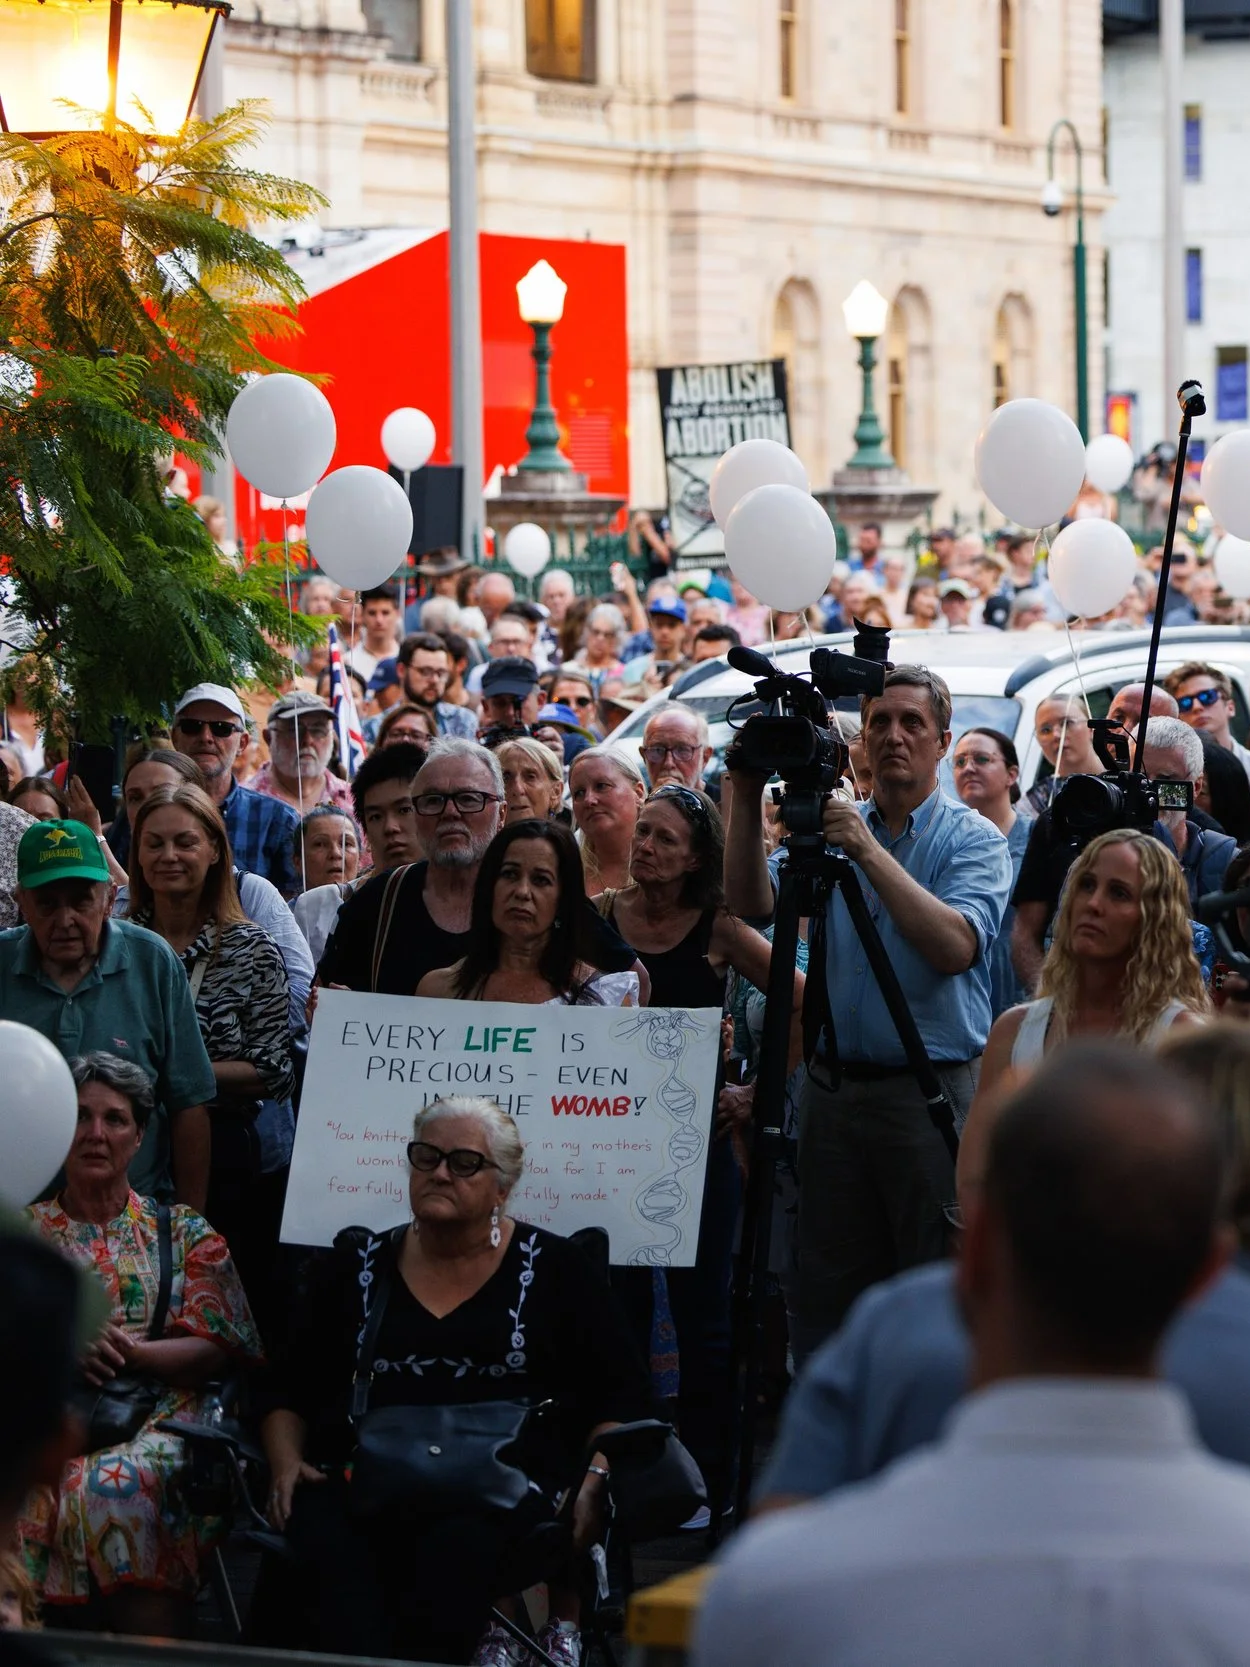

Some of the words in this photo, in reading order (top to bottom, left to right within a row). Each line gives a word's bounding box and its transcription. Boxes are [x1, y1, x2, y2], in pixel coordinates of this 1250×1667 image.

[671, 363, 776, 404] ABOLISH
[667, 411, 790, 455] ABORTION
[341, 1021, 446, 1052] EVERY
[463, 1025, 537, 1053] LIFE
[562, 1032, 585, 1052] IS
[366, 1055, 514, 1084] PRECIOUS
[558, 1065, 628, 1086] EVEN
[551, 1094, 647, 1118] WOMB!
[542, 1137, 553, 1150] in
[561, 1142, 581, 1157] my
[592, 1138, 652, 1152] mother's
[524, 1158, 549, 1174] You
[563, 1162, 585, 1175] for
[597, 1161, 606, 1175] I
[617, 1167, 636, 1175] am
